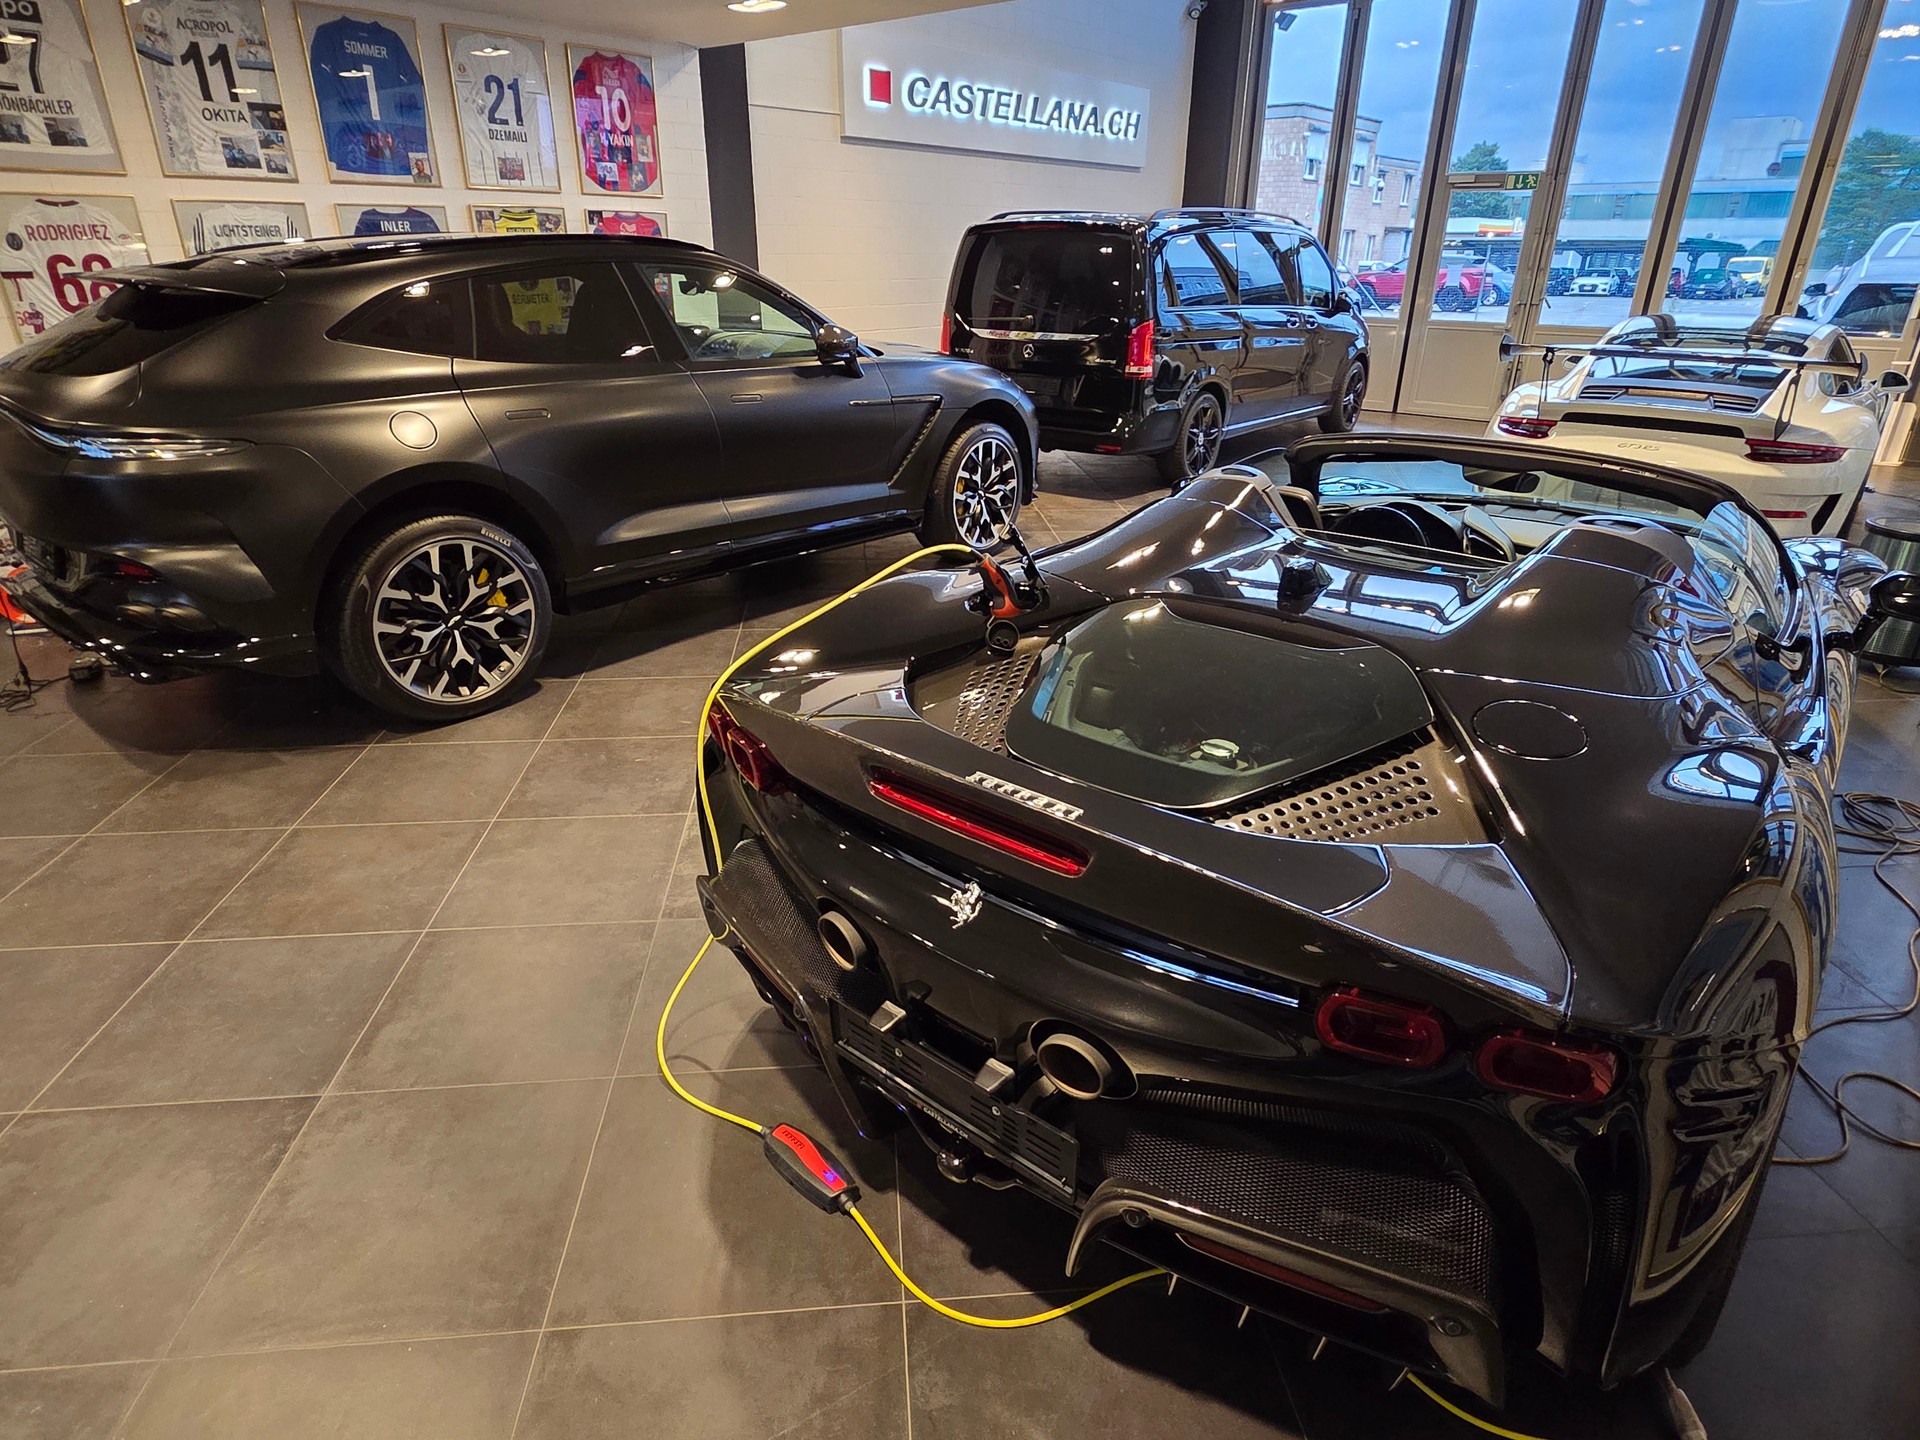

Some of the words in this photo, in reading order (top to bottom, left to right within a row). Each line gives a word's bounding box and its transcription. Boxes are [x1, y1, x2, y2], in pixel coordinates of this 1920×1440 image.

[176, 17, 234, 34] ACROPOL
[343, 39, 389, 59] SOMMER
[180, 41, 241, 103] 11
[362, 63, 381, 121] 1
[484, 74, 524, 126] 21
[202, 108, 248, 123] OKITA
[595, 85, 632, 132] 10
[907, 76, 1141, 139] CASTELLANA.CH
[488, 128, 528, 143] DZEMAILI
[608, 133, 634, 147] YAKIN
[24, 224, 112, 241] RODRIGUEZ
[213, 224, 283, 238] LICHTSTEINER
[380, 220, 412, 233] INLER
[481, 527, 511, 547] PIRELLI
